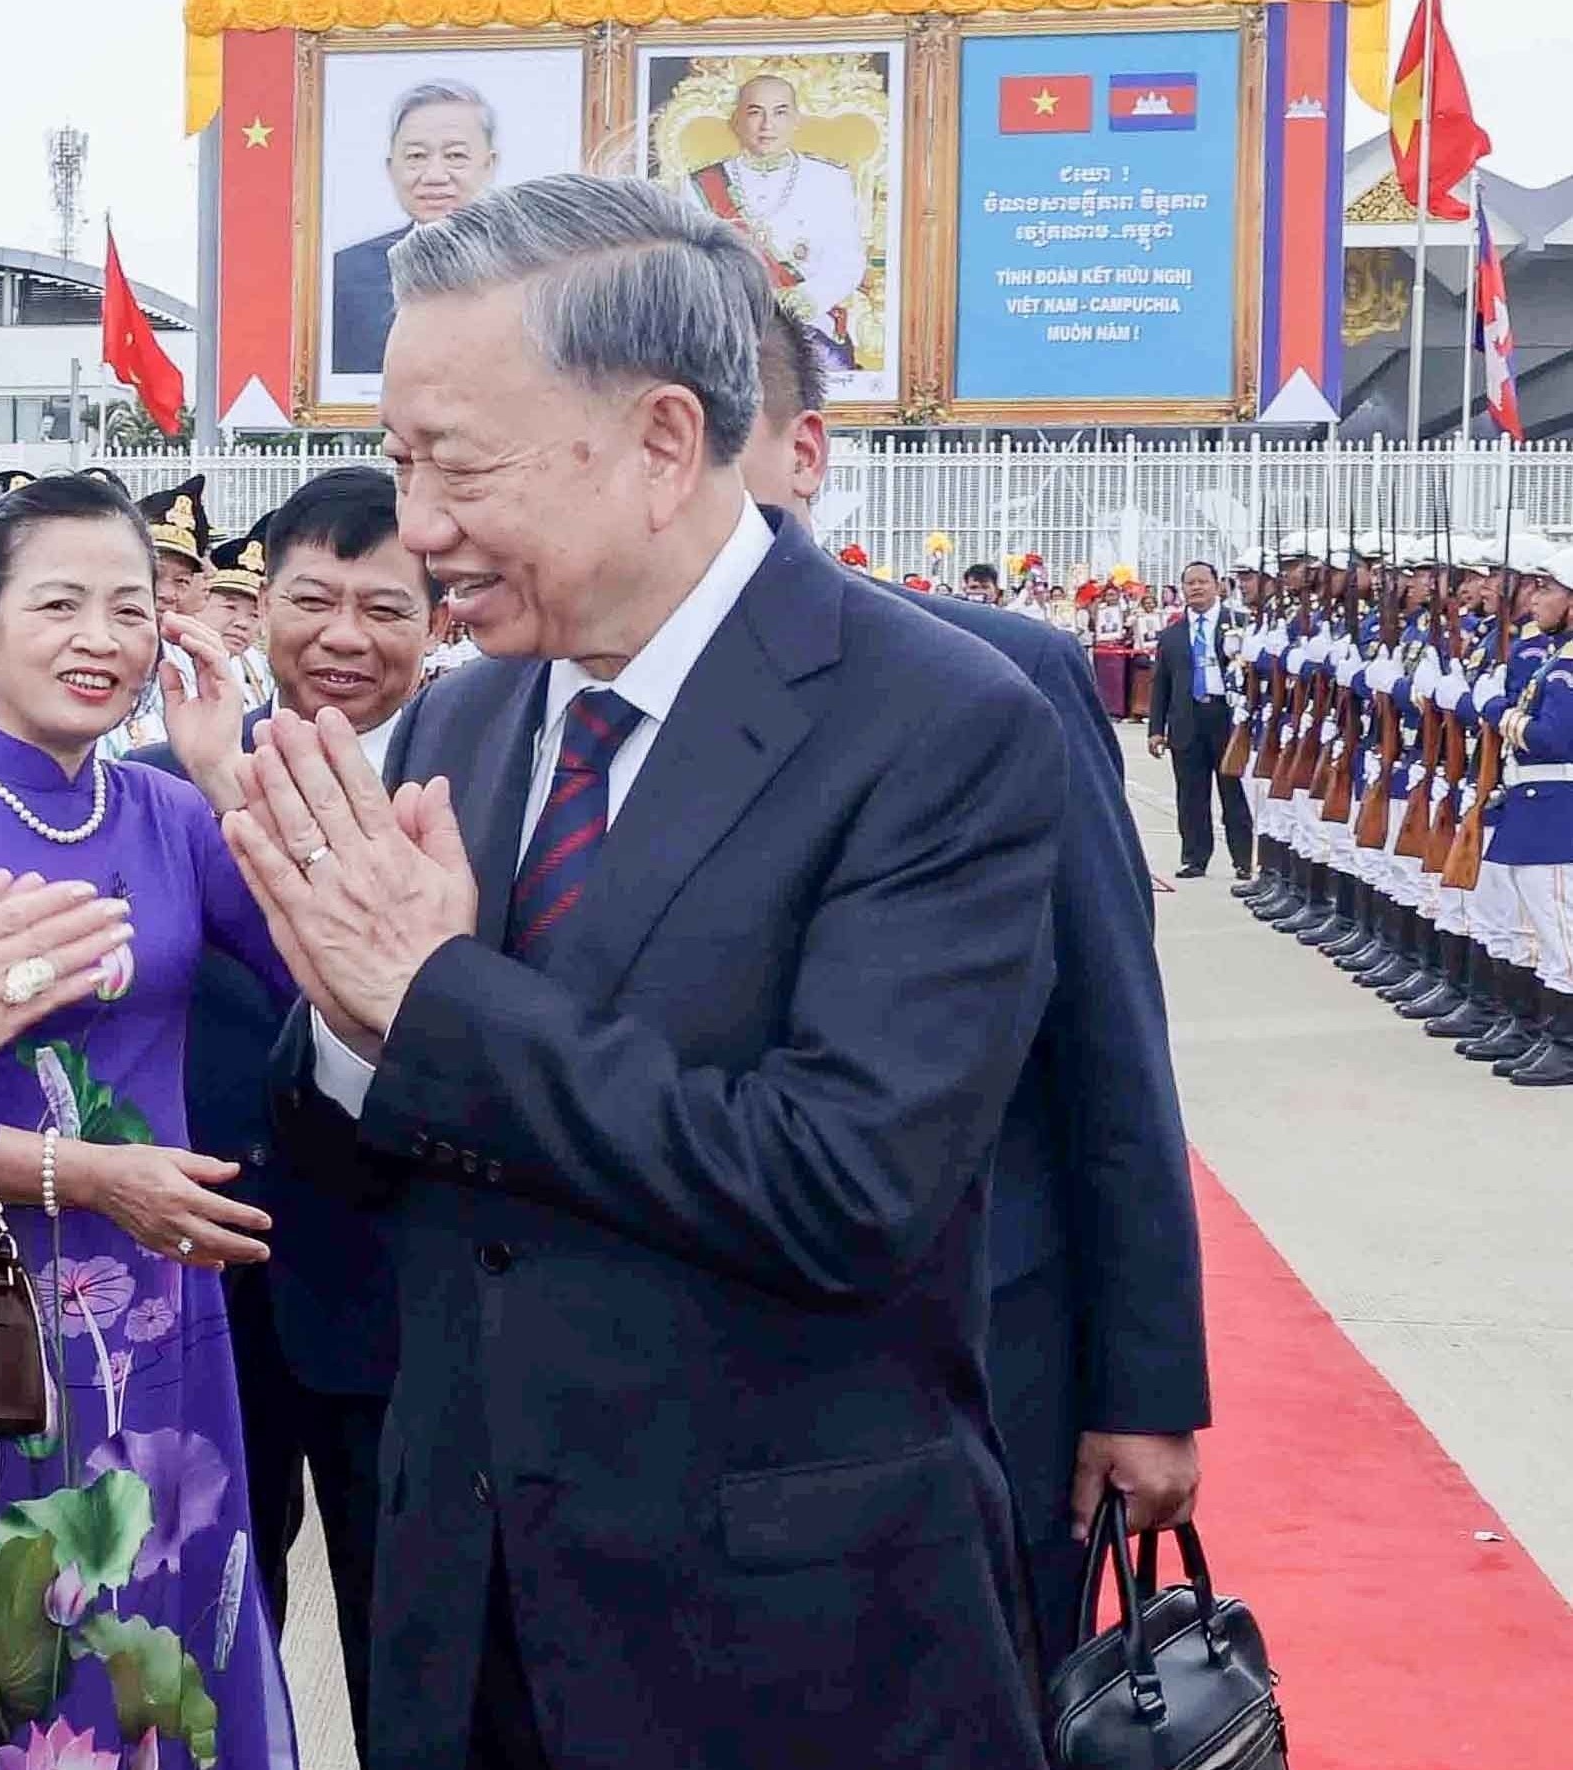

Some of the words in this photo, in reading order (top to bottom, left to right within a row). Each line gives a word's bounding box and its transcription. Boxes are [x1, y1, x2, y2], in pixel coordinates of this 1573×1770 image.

[1122, 165, 1130, 182] !
[995, 267, 1033, 285] TÌNH
[1034, 265, 1079, 285] ĐOÀN
[1081, 265, 1114, 284] KẾT
[1115, 264, 1150, 284] HỮU
[1152, 268, 1193, 290] NGHỊ
[1006, 295, 1041, 318] VIỆT
[1043, 297, 1078, 313] NAM
[1090, 296, 1182, 313] CAMPUCHIA
[1047, 323, 1093, 342] MUÔN
[1095, 323, 1132, 341] NĂM
[1134, 325, 1140, 341] !
